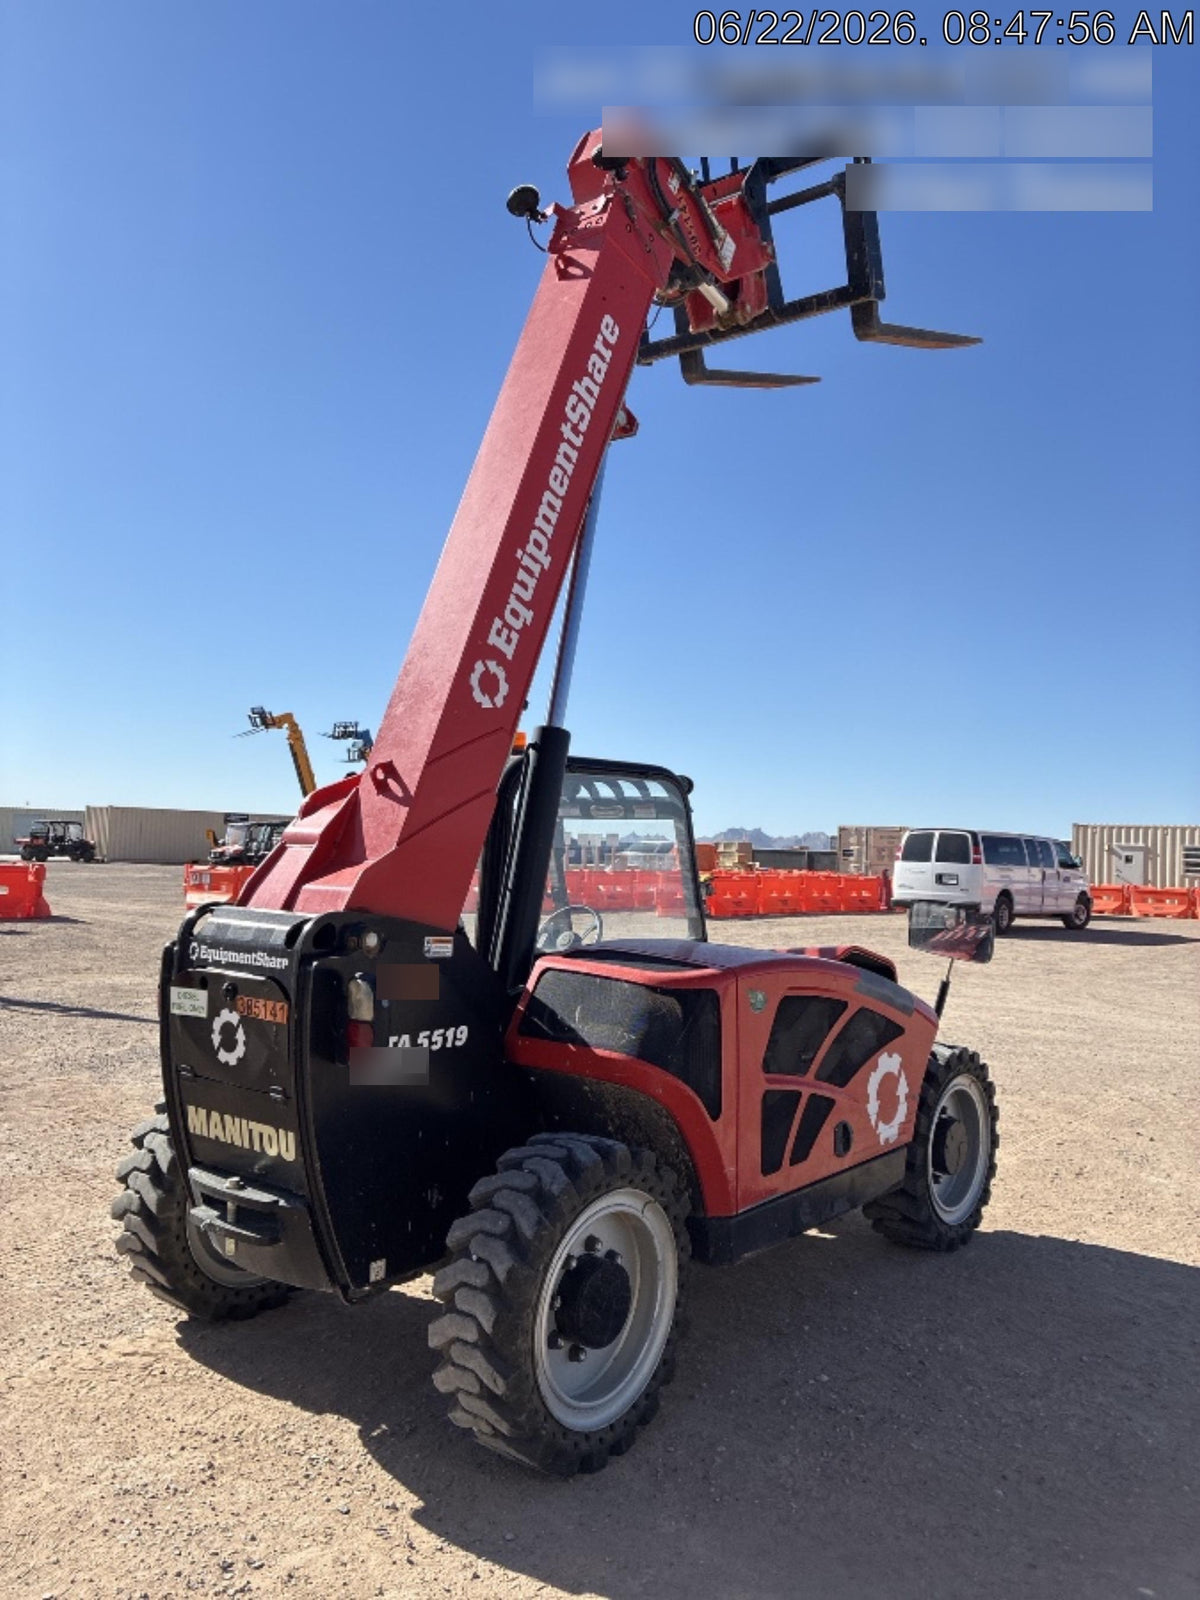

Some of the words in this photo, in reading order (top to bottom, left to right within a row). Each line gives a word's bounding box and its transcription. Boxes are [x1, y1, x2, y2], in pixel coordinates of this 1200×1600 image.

[487, 313, 622, 660] EquipmentShare
[417, 1025, 468, 1051] 5519
[187, 1105, 296, 1162] MANITOU
